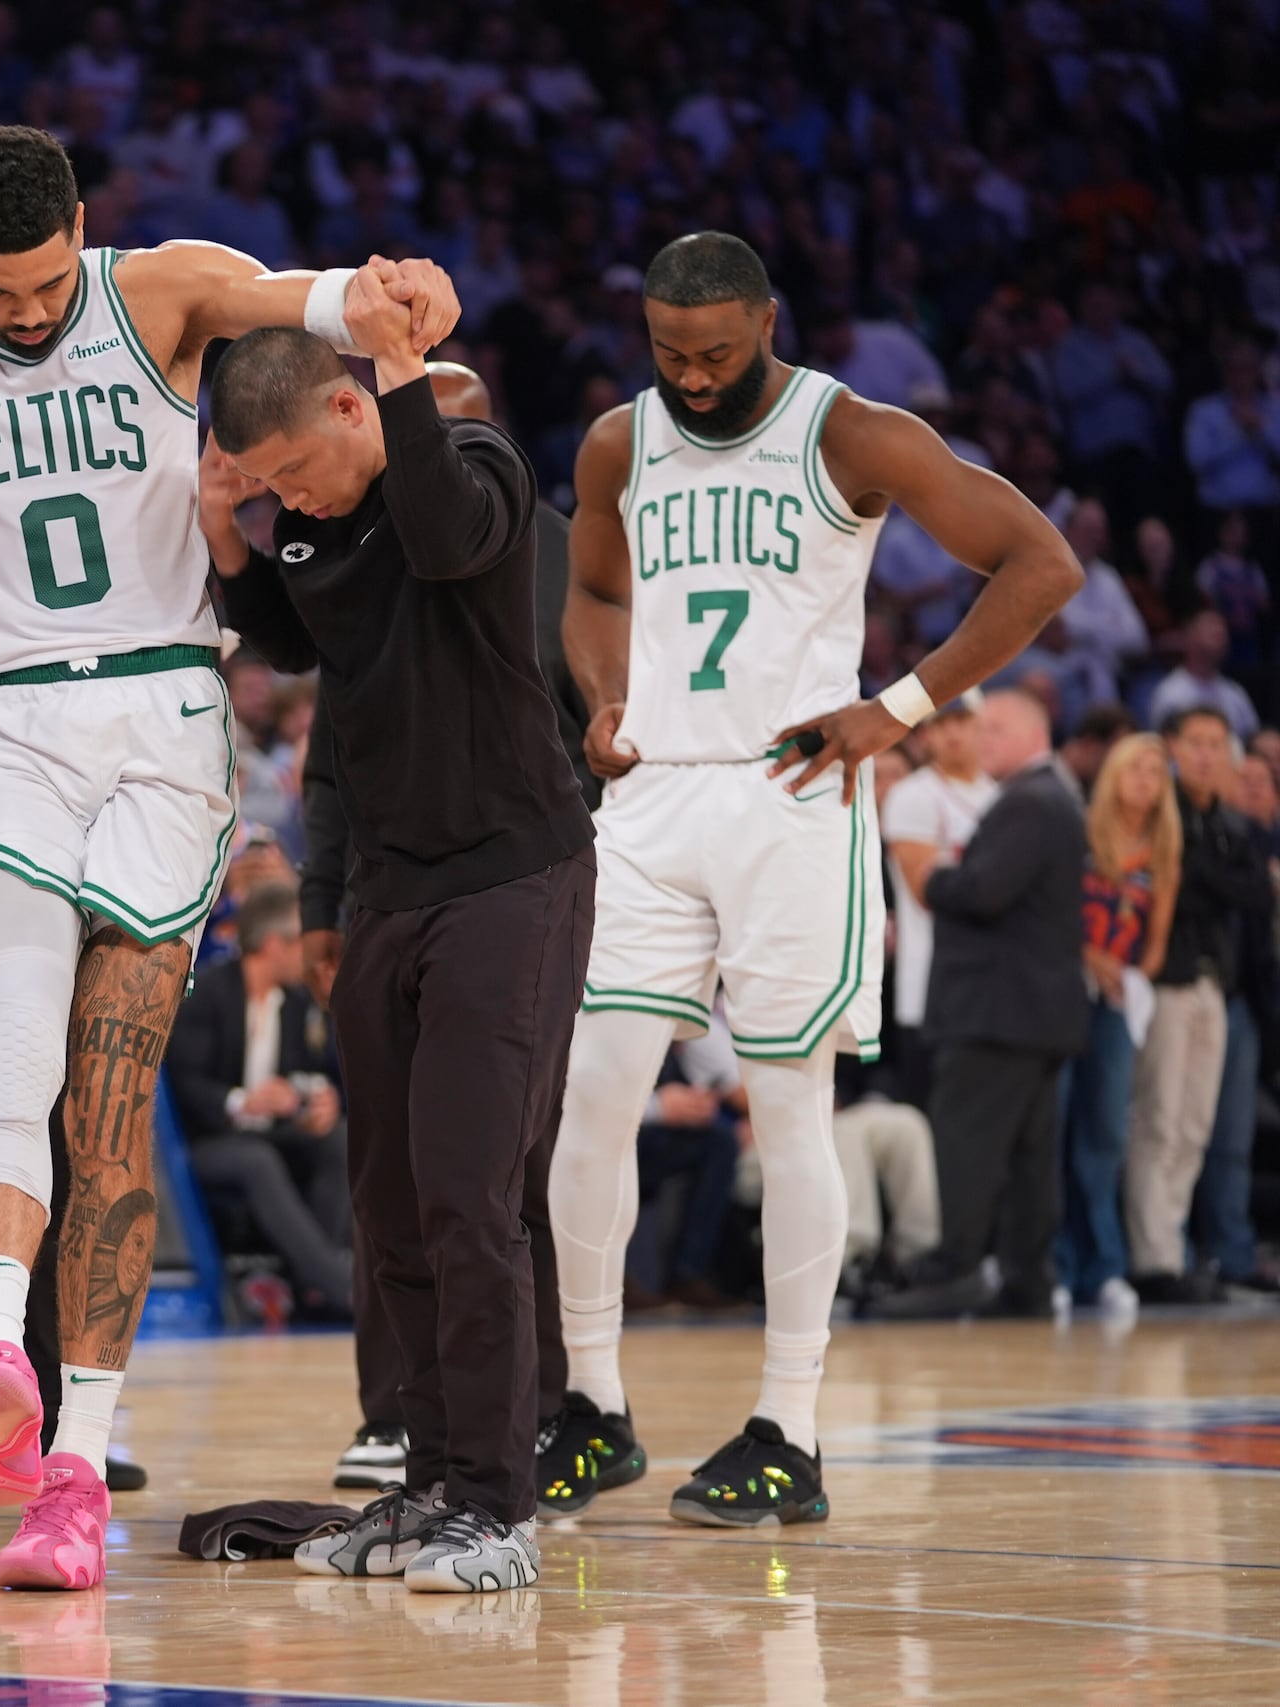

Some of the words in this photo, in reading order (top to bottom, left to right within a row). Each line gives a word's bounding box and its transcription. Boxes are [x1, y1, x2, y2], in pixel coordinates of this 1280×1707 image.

[67, 336, 121, 360] Amica
[748, 447, 799, 464] Amica
[20, 493, 112, 610] 0
[638, 486, 803, 581] CELTICS
[687, 590, 750, 692] 7
